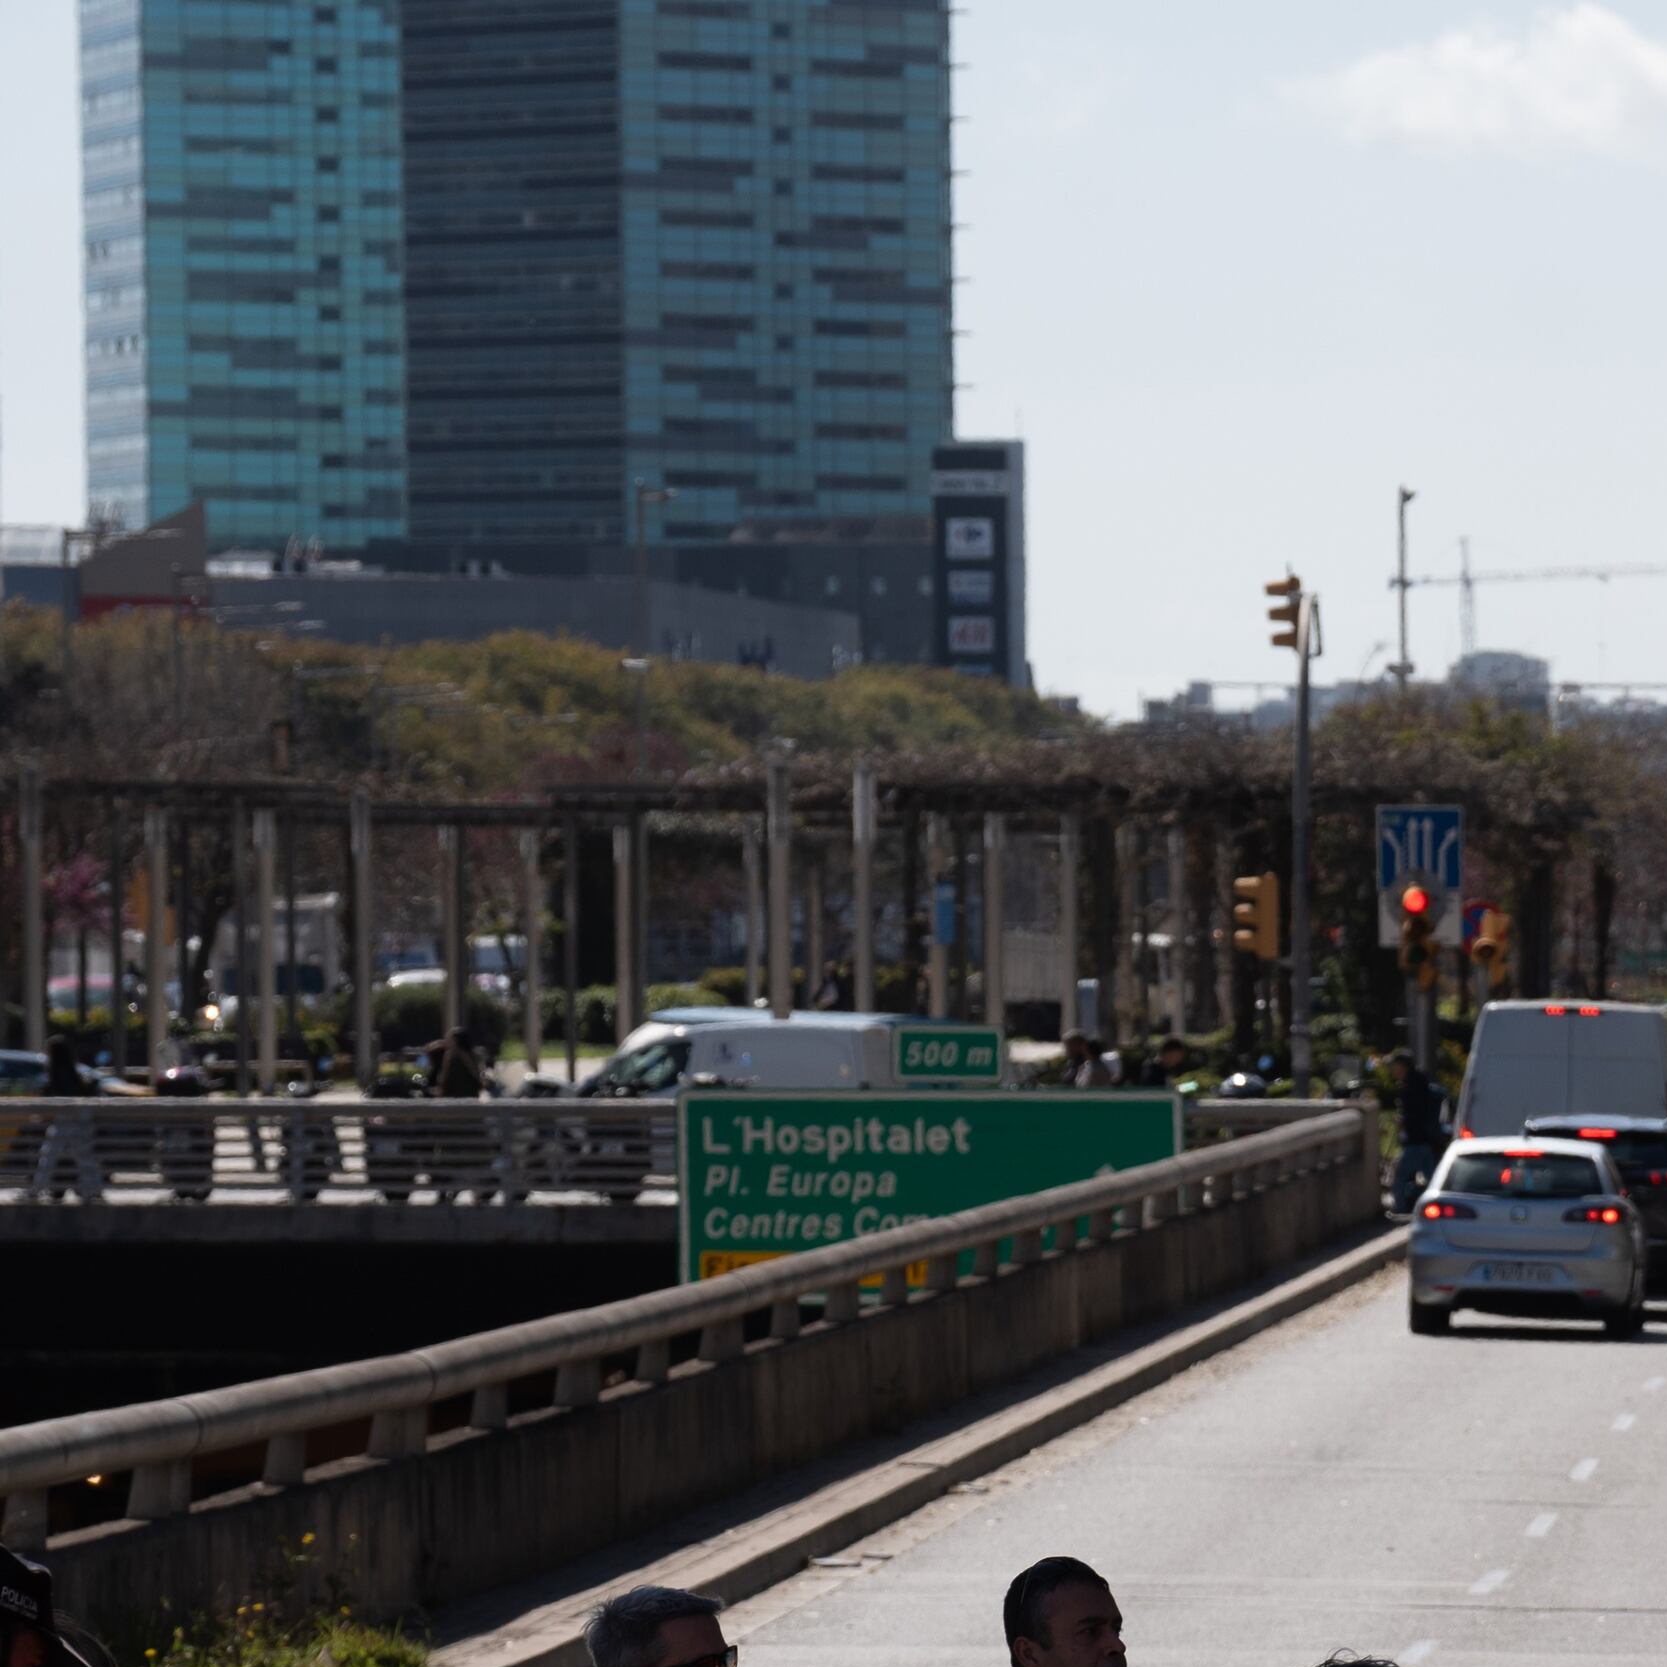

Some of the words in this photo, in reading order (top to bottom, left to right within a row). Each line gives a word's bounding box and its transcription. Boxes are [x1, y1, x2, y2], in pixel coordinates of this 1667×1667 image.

[905, 1041, 959, 1066] 500
[966, 1046, 992, 1066] m
[702, 1116, 972, 1163] L'Hospitalet
[704, 1165, 749, 1197] Pl.
[766, 1165, 898, 1204] Europa
[704, 1207, 843, 1239] Centres
